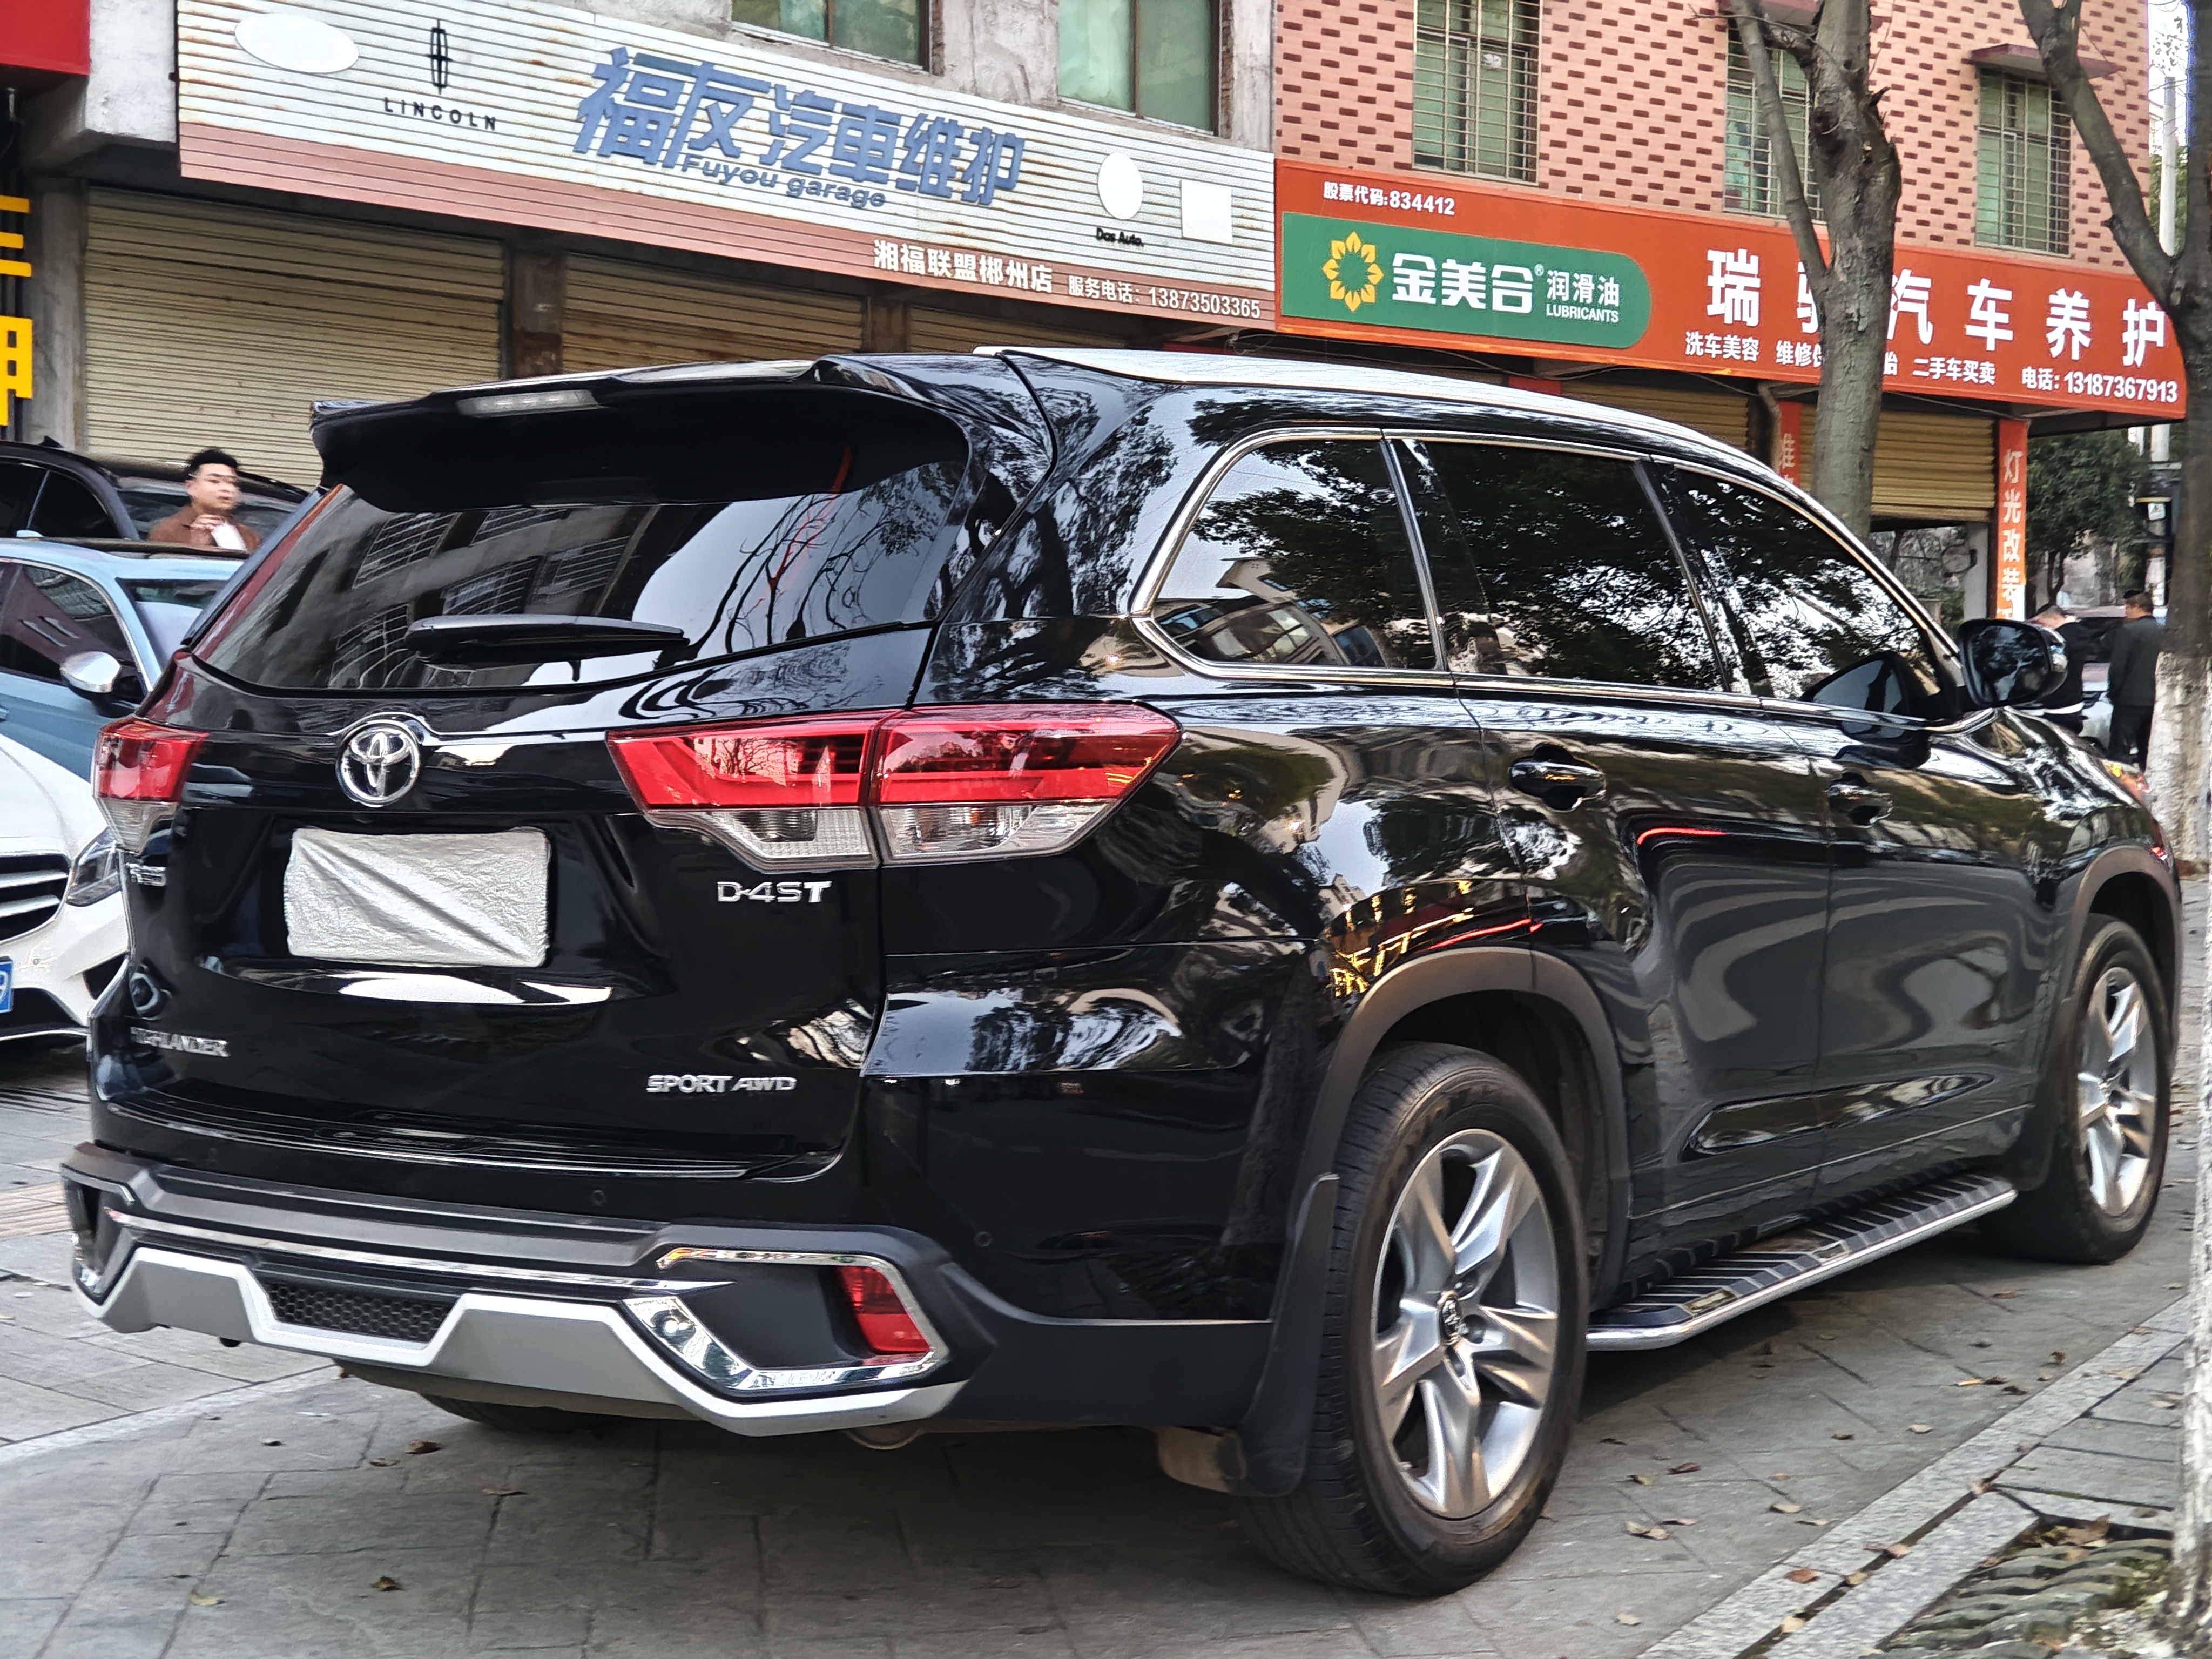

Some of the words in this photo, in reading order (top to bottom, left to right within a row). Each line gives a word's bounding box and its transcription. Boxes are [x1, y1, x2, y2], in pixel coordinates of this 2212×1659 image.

[384, 97, 496, 131] LINCOLN
[682, 154, 778, 189] Fuyou
[786, 175, 886, 208] garage
[1096, 227, 1116, 242] Das
[873, 239, 1053, 294] 湘福联盟郴州店
[1546, 269, 1620, 308] 润滑油
[1546, 302, 1620, 324] LUBRICANTS
[1684, 331, 1760, 362] 洗车美容
[1912, 356, 1996, 386] 二手车买卖
[646, 1074, 734, 1094] SPORT
[730, 1076, 798, 1091] AWD
